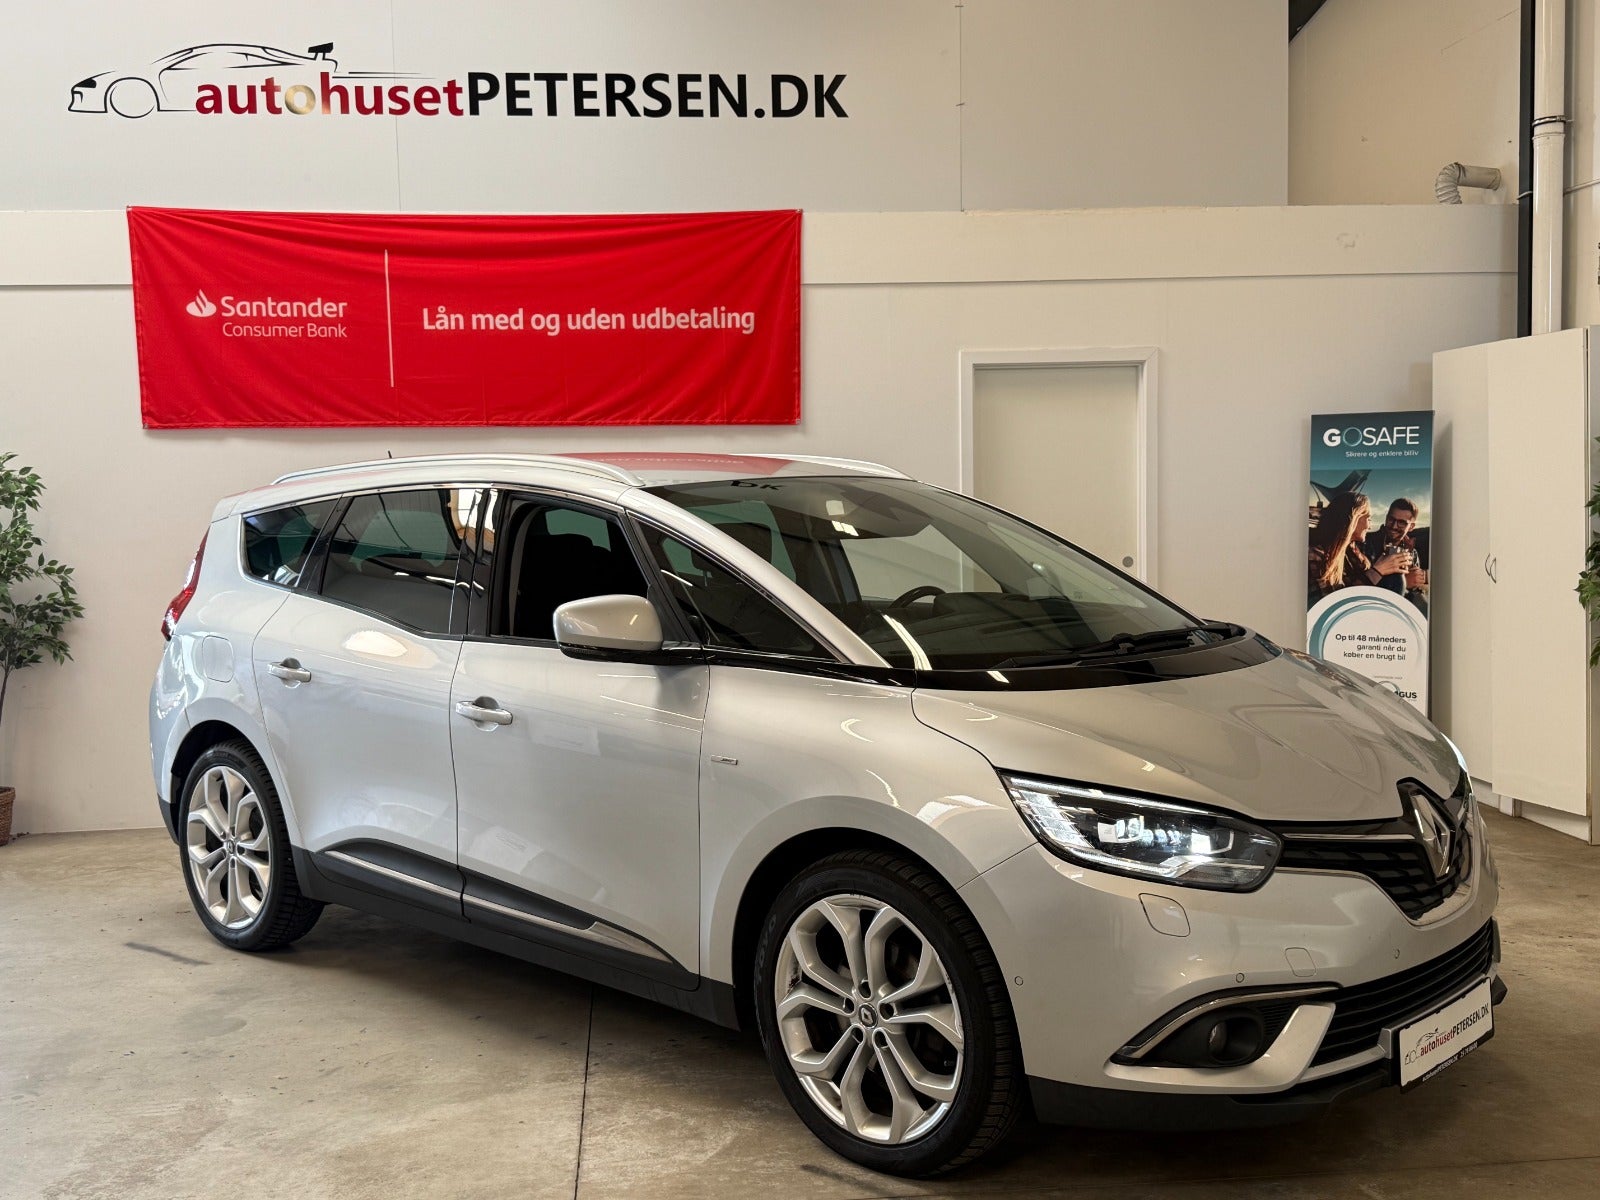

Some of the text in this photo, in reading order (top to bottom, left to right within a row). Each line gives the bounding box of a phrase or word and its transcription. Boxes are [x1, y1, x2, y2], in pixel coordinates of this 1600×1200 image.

[195, 71, 849, 118] autohusetPETERSEN.DK
[221, 296, 347, 318] Santander
[222, 322, 348, 338] Consumer Bank
[423, 306, 755, 336] Lån med og uden udbetaling
[1323, 426, 1420, 447] GOSAFE
[1335, 633, 1347, 642] Op
[1356, 634, 1367, 642] 48
[1368, 635, 1407, 643] måneders
[1382, 644, 1394, 652] når
[1376, 652, 1396, 661] brugt
[1419, 1003, 1489, 1057] autohusetPETERSEN.DK
